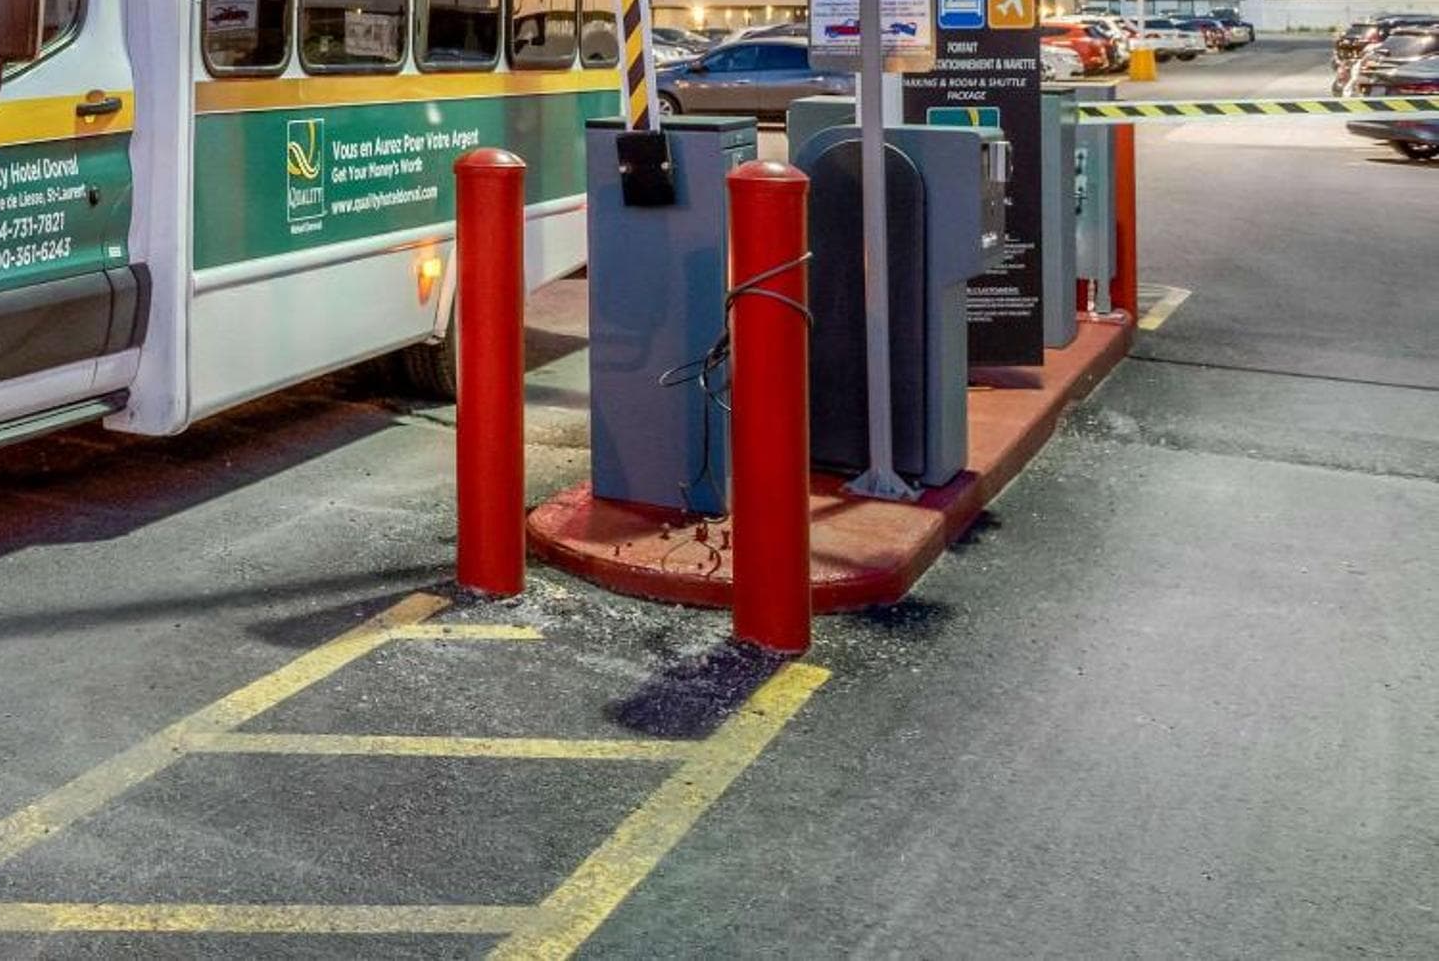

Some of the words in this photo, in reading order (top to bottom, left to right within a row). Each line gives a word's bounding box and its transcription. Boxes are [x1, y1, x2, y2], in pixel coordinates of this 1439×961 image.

[989, 77, 1027, 87] SHUTTLE
[947, 90, 987, 101] PACKAGE
[332, 140, 358, 161] Vous
[359, 141, 373, 158] en
[374, 136, 401, 156] Aurez
[403, 134, 425, 153] Pour
[425, 131, 450, 150] Votre
[451, 127, 479, 150] Argent
[10, 158, 41, 184] Hotel
[43, 152, 79, 178] Dorval
[331, 166, 347, 183] Get
[348, 165, 367, 180] Your
[368, 160, 400, 179] Money's
[400, 156, 423, 174] Worth
[6, 193, 17, 209] de
[47, 183, 87, 203] St-Laurent
